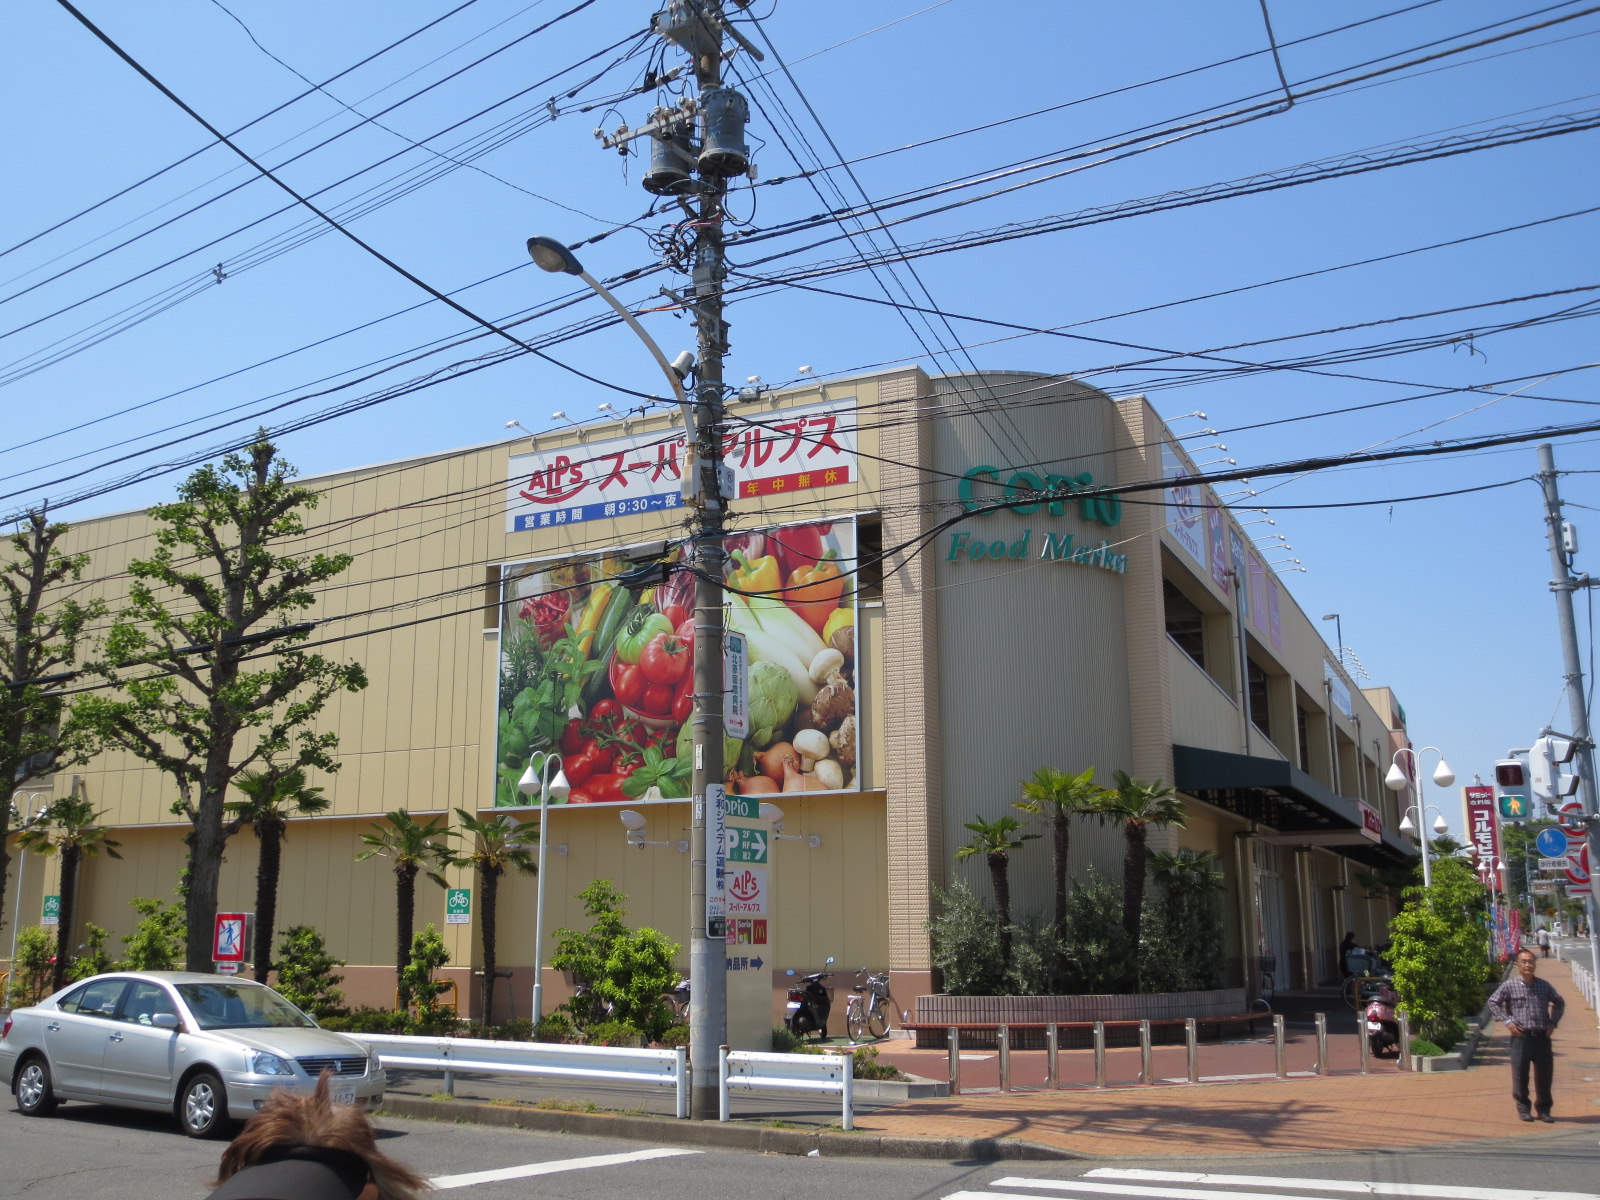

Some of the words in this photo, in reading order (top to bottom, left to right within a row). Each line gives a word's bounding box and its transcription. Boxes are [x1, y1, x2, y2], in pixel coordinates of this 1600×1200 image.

[528, 455, 583, 495] ALPS
[747, 470, 837, 494] 年中無休
[525, 508, 582, 528] 営業時間
[945, 529, 1032, 561] Food
[1037, 532, 1128, 574] Market
[742, 830, 751, 839] 2F
[742, 841, 751, 850] RF
[733, 870, 758, 895] ALPS
[729, 902, 761, 913] スーパーアルプス
